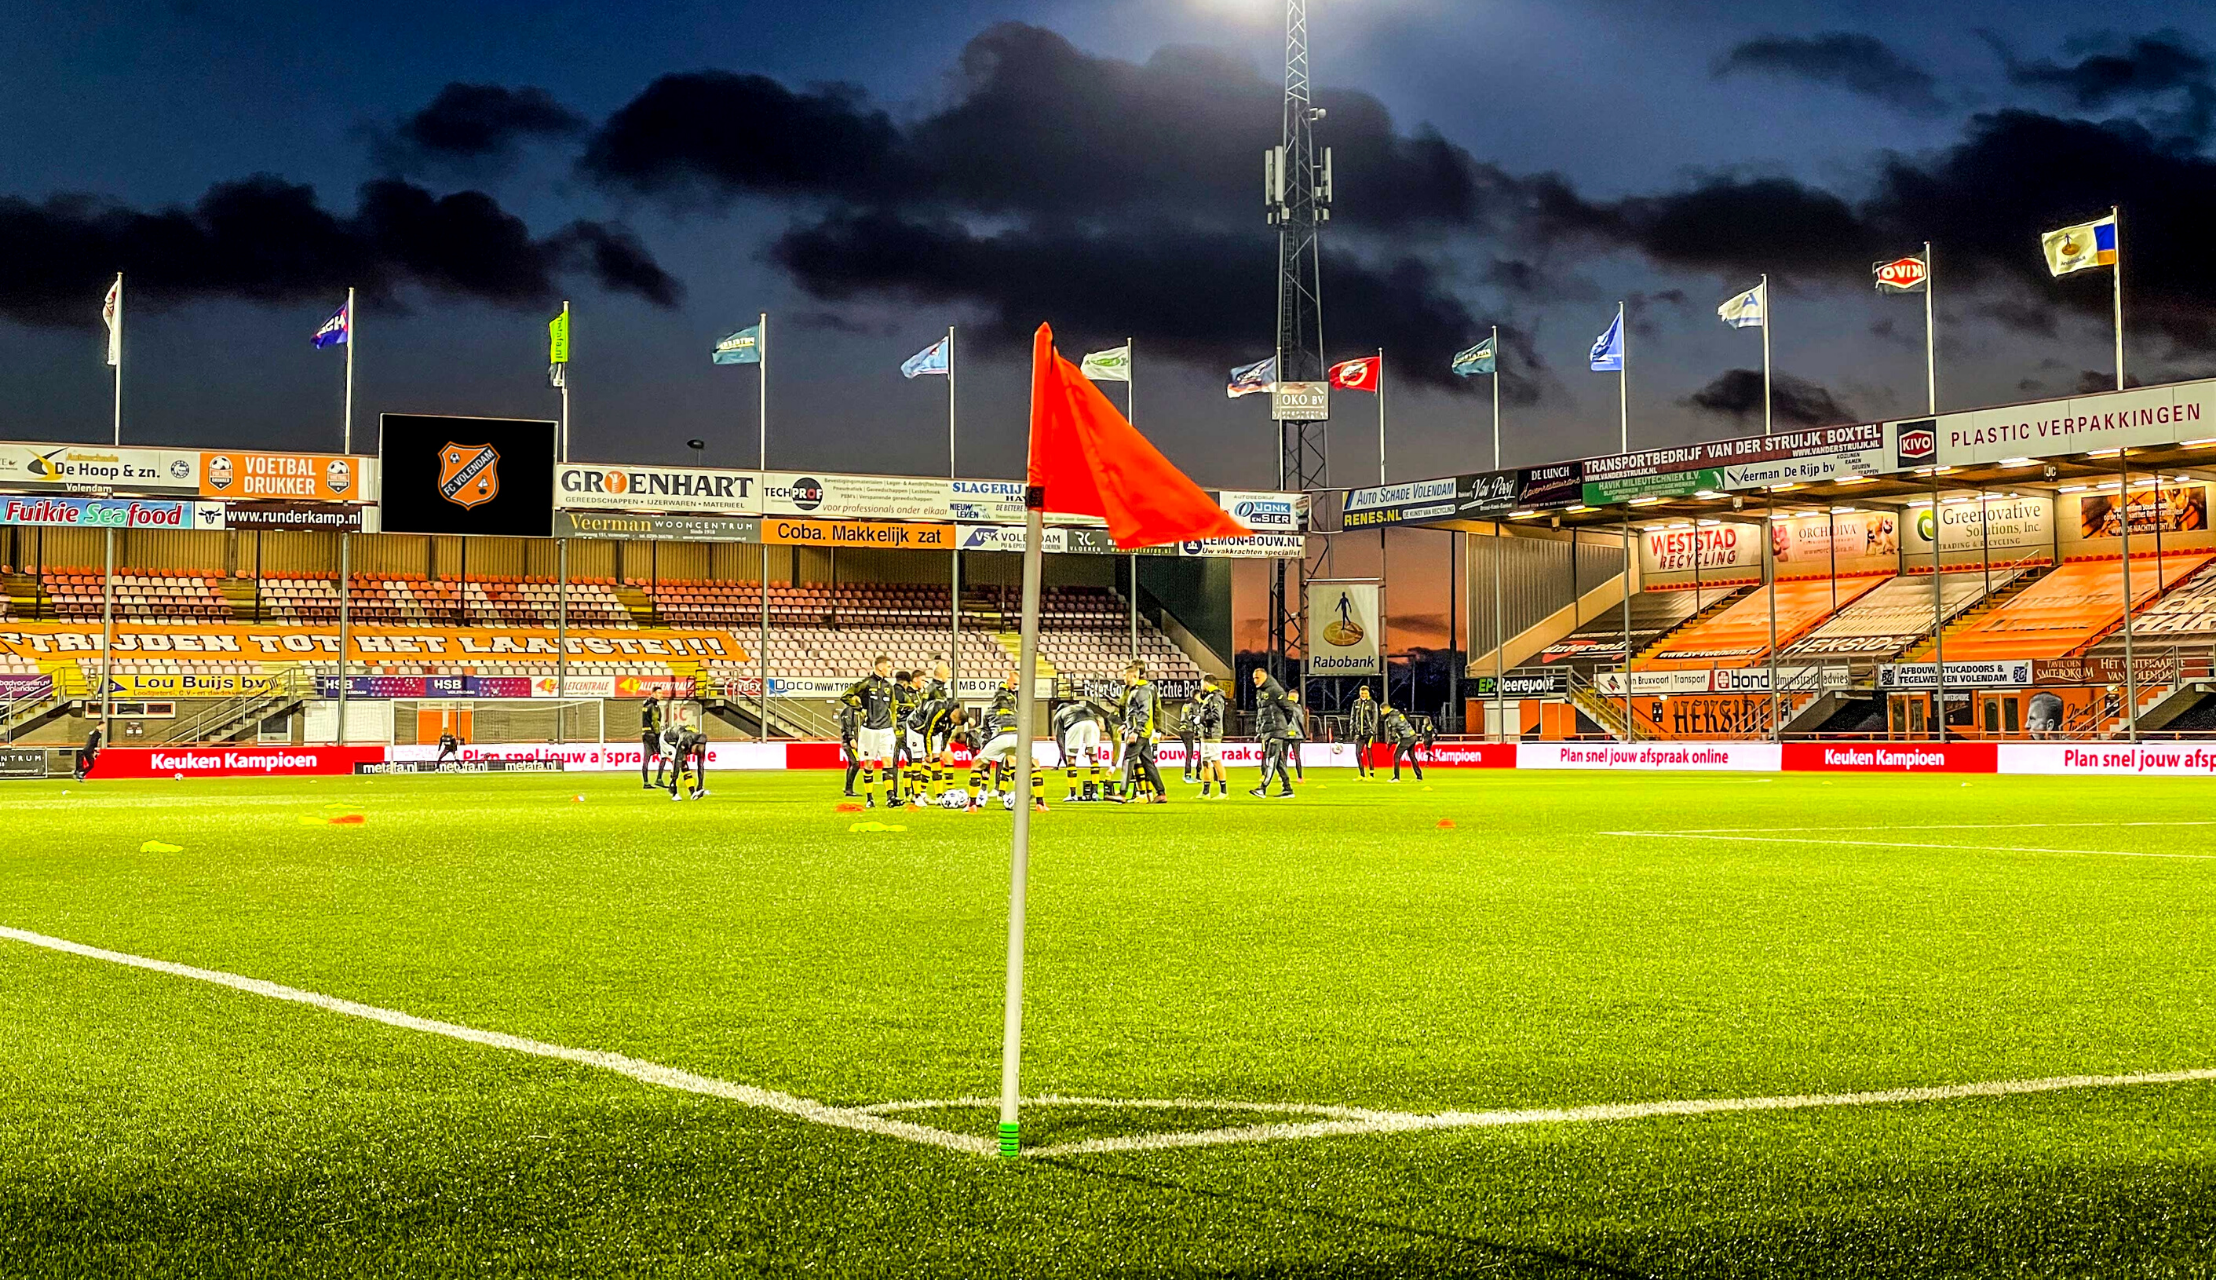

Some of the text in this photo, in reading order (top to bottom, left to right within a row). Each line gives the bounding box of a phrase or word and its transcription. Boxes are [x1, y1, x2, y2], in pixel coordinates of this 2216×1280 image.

[1312, 395, 1325, 405] BV
[1951, 402, 2201, 448] PLASTIC VERPAKKINGEN
[1585, 424, 1882, 474] TRANSPORTBEDRIJF VAN DER STRUIJK BOXTEL
[1792, 440, 1880, 458] WWW.VANDERSTRUIJK.NL
[1901, 436, 1931, 452] KIVO
[55, 462, 75, 475] De
[79, 463, 119, 480] Hoop
[123, 464, 134, 477] &
[138, 467, 161, 478] zn.
[245, 456, 316, 476] VOETBAL
[443, 448, 495, 497] FC VOLENDAM
[1531, 466, 1570, 481] DE LUNCH
[1785, 467, 1797, 477] De
[1800, 463, 1820, 477] Rijp
[1823, 461, 1835, 473] bv
[66, 483, 113, 493] Volendam
[244, 476, 315, 495] DRUKKER
[561, 470, 754, 498] GROENHART
[953, 482, 1022, 494] SLAGERIJ
[1473, 478, 1489, 499] Van
[1599, 471, 1701, 490] HAVIK MILIEUTECHNIEK B.V.
[764, 487, 823, 501] TECHPROF
[866, 487, 908, 495] Gereedschappen
[566, 496, 745, 509] GEREEDSCHAPPEN IJZERWAREN MATERIEEL
[843, 504, 895, 514] professionals
[896, 506, 920, 515] onder
[924, 506, 948, 516] elkaar
[950, 503, 973, 511] NIEUW
[995, 504, 1002, 512] DE
[1255, 502, 1289, 513] JONK
[5, 501, 183, 527] Fuikie Seafood
[226, 509, 361, 527] www.runderkamp.nl
[957, 510, 979, 519] LEVEN
[1344, 509, 1402, 526] RENES.NL
[1409, 510, 1423, 518] KUNST
[1423, 509, 1432, 517] VAN
[1432, 505, 1455, 515] RECYCLING
[568, 512, 753, 532] Veerman WOONCENTRUM
[2024, 521, 2041, 533] Inc.
[778, 523, 941, 546] Coba. Makkelijk zat
[975, 532, 999, 542] VSK
[1203, 535, 1303, 547] LEMON-BOUW.NL
[1651, 528, 1737, 556] WESTSTAD
[1202, 547, 1301, 557] Uw vakkrachten specialist
[1938, 541, 1970, 551] TRADING
[1659, 550, 1737, 570] RECYCLING
[249, 634, 728, 657] TOT HET LAATSTE!!!
[1782, 635, 1917, 654] HEKSIDE
[1313, 655, 1375, 669] Rabobank
[1901, 666, 1938, 675] AFBOUW,
[1997, 664, 2004, 672] &
[135, 676, 267, 691] Lou Buijs bv
[434, 679, 462, 689] HSB
[1638, 674, 1706, 685] Bruxvoort Transport
[1731, 668, 1849, 688] bond advies
[1959, 673, 2008, 683] VOLENDAM
[2107, 671, 2126, 681] VAN
[1157, 680, 1183, 699] Echte
[151, 752, 318, 773] Keuken Kampioen
[1435, 748, 1482, 764] Kampioen
[1560, 747, 1729, 766] Plan snel jouw afspraak online
[1824, 748, 1945, 770] Keuken Kampioen
[2064, 749, 2182, 772] Plan snel jouw
[363, 761, 418, 774] metafa.nl
[505, 760, 557, 772] metafa.nl
